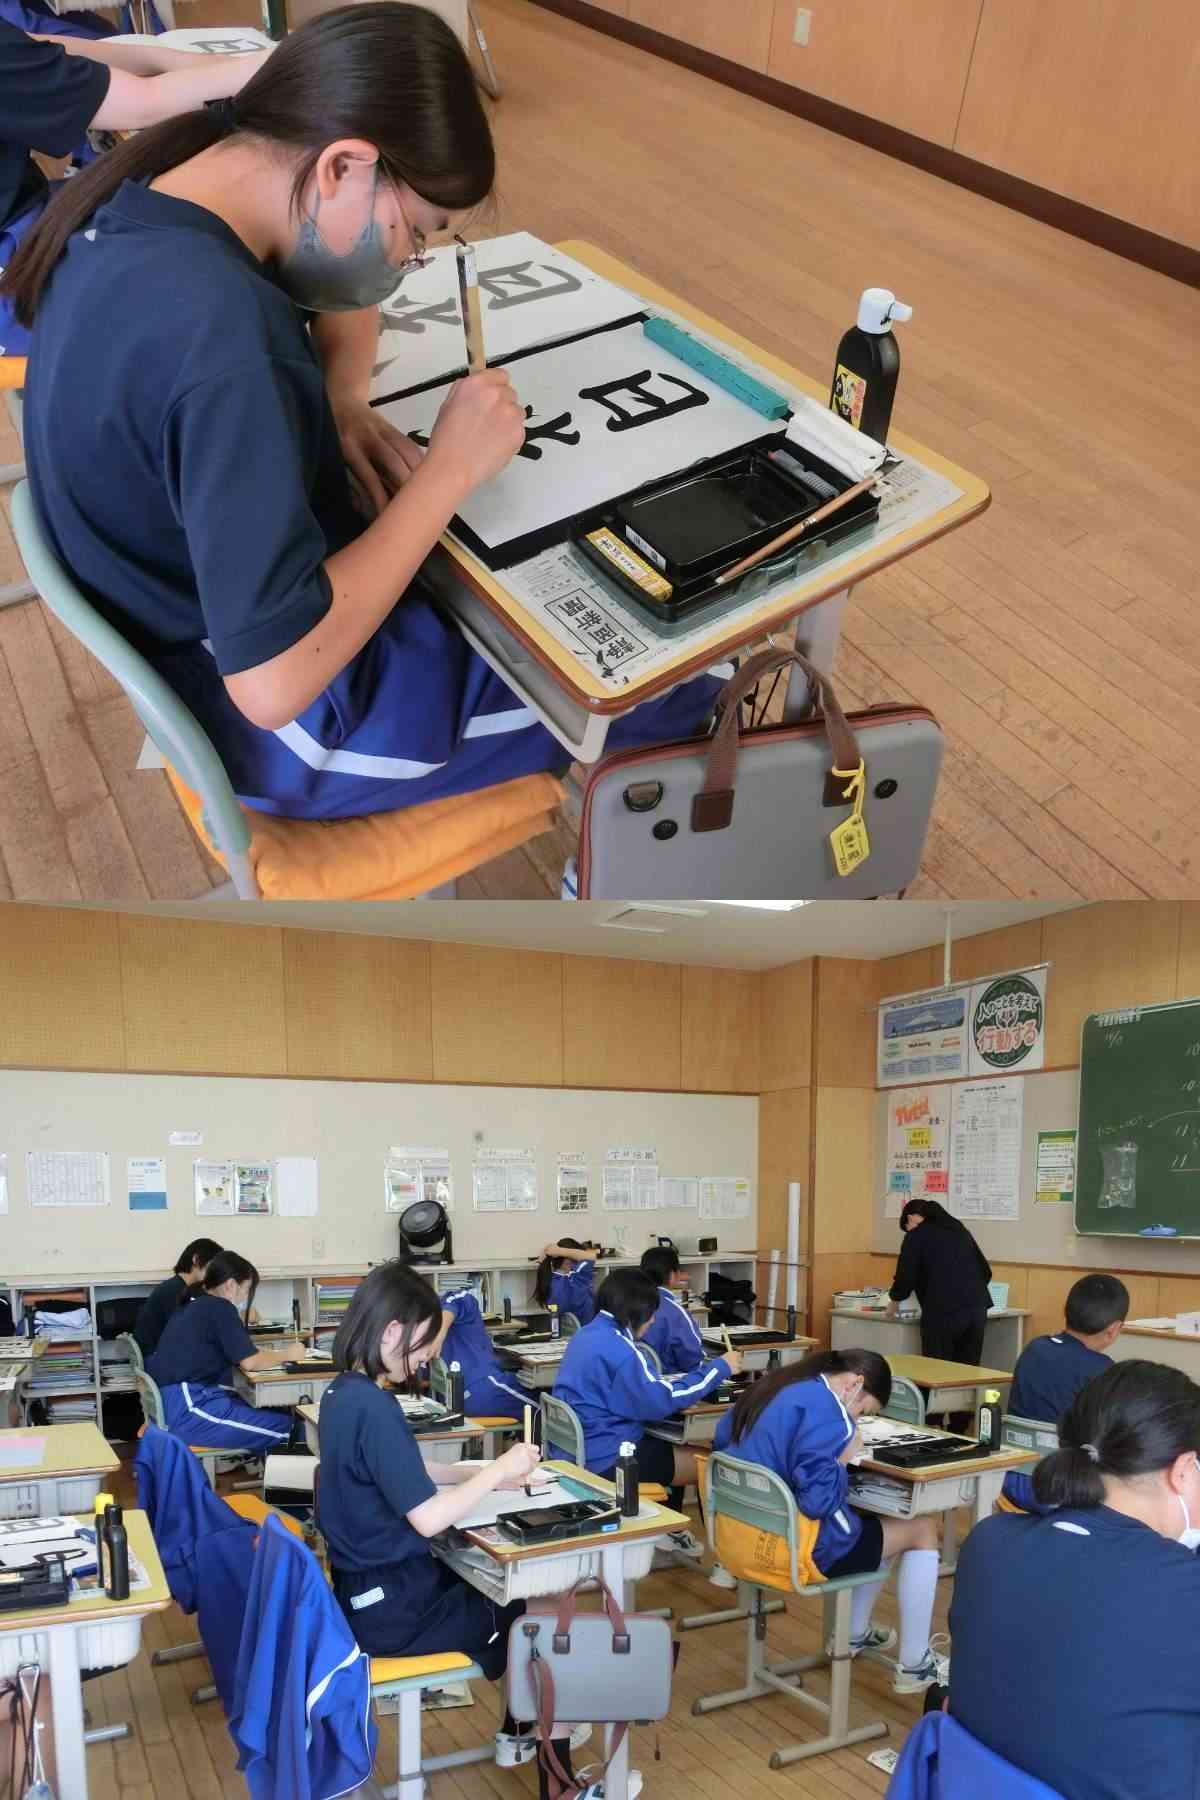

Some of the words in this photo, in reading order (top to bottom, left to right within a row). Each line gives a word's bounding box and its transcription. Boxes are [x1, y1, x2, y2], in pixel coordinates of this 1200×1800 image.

[558, 596, 635, 659] 静岡新聞
[977, 992, 1040, 1023] 人のことを考えて
[976, 1019, 1038, 1054] 行動する
